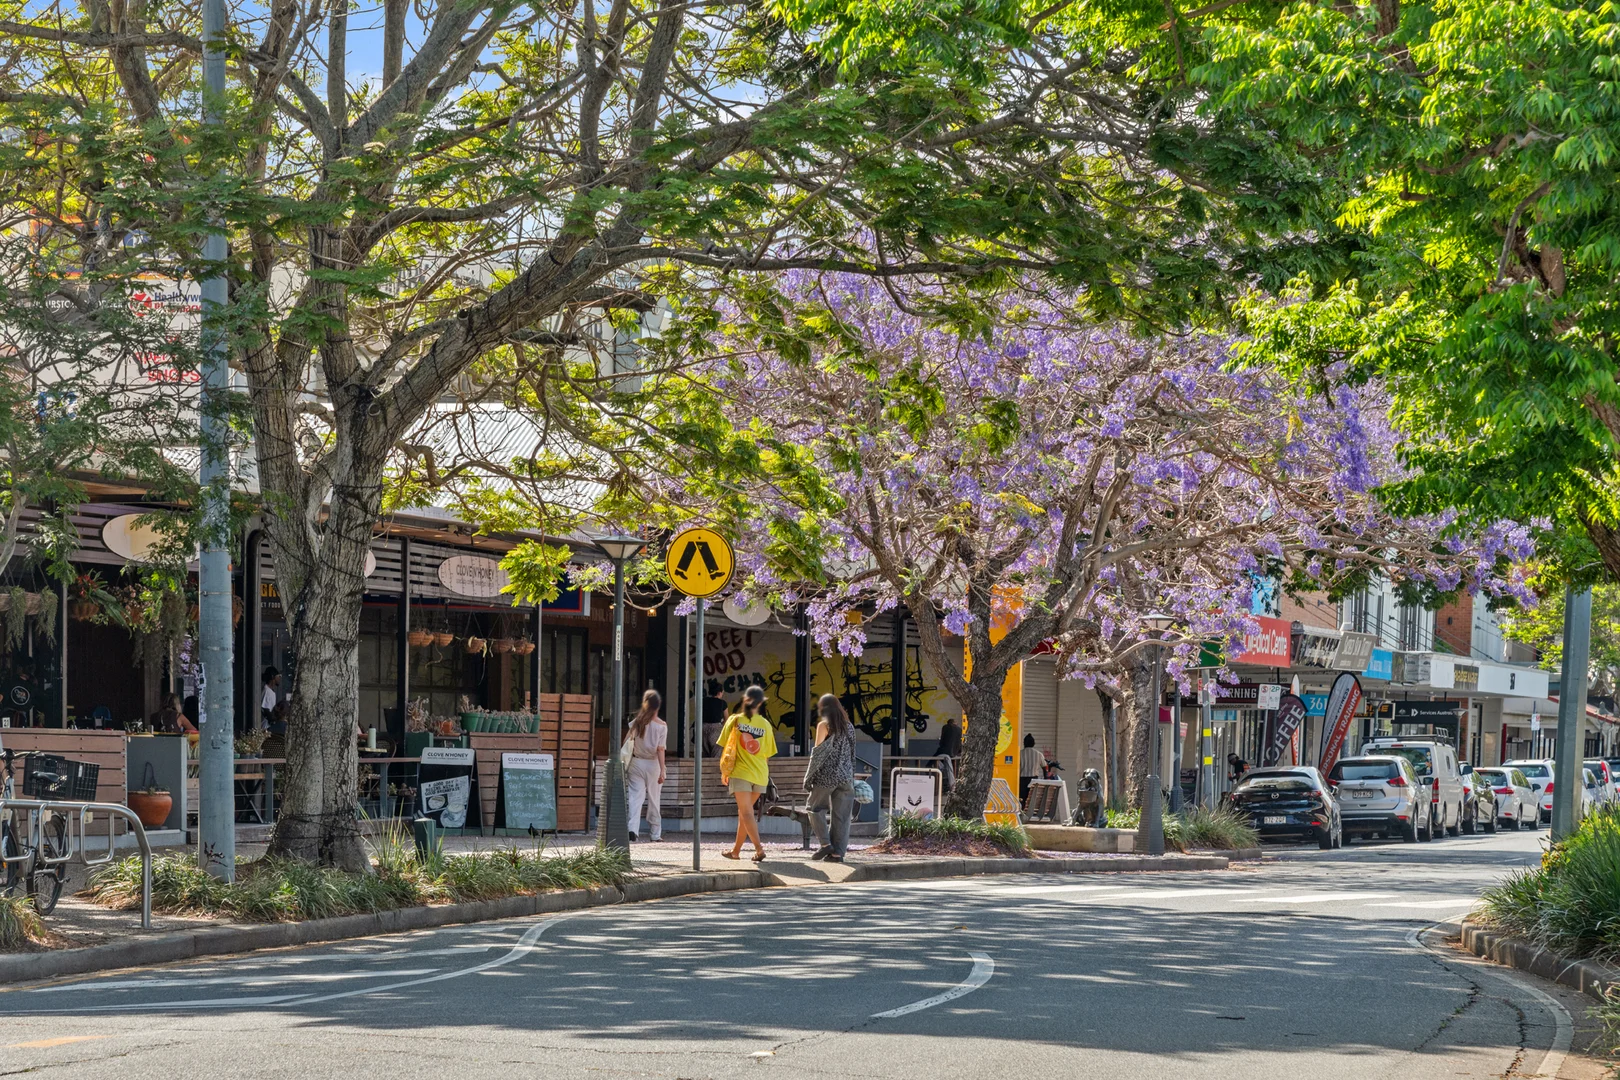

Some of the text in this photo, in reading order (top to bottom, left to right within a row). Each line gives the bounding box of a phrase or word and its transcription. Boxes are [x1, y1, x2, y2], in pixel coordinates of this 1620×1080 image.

[1270, 629, 1288, 657] Centre
[1265, 704, 1305, 761] OFFEE
[1321, 733, 1342, 776] ERSONAL
[1339, 689, 1360, 733] TRAINING
